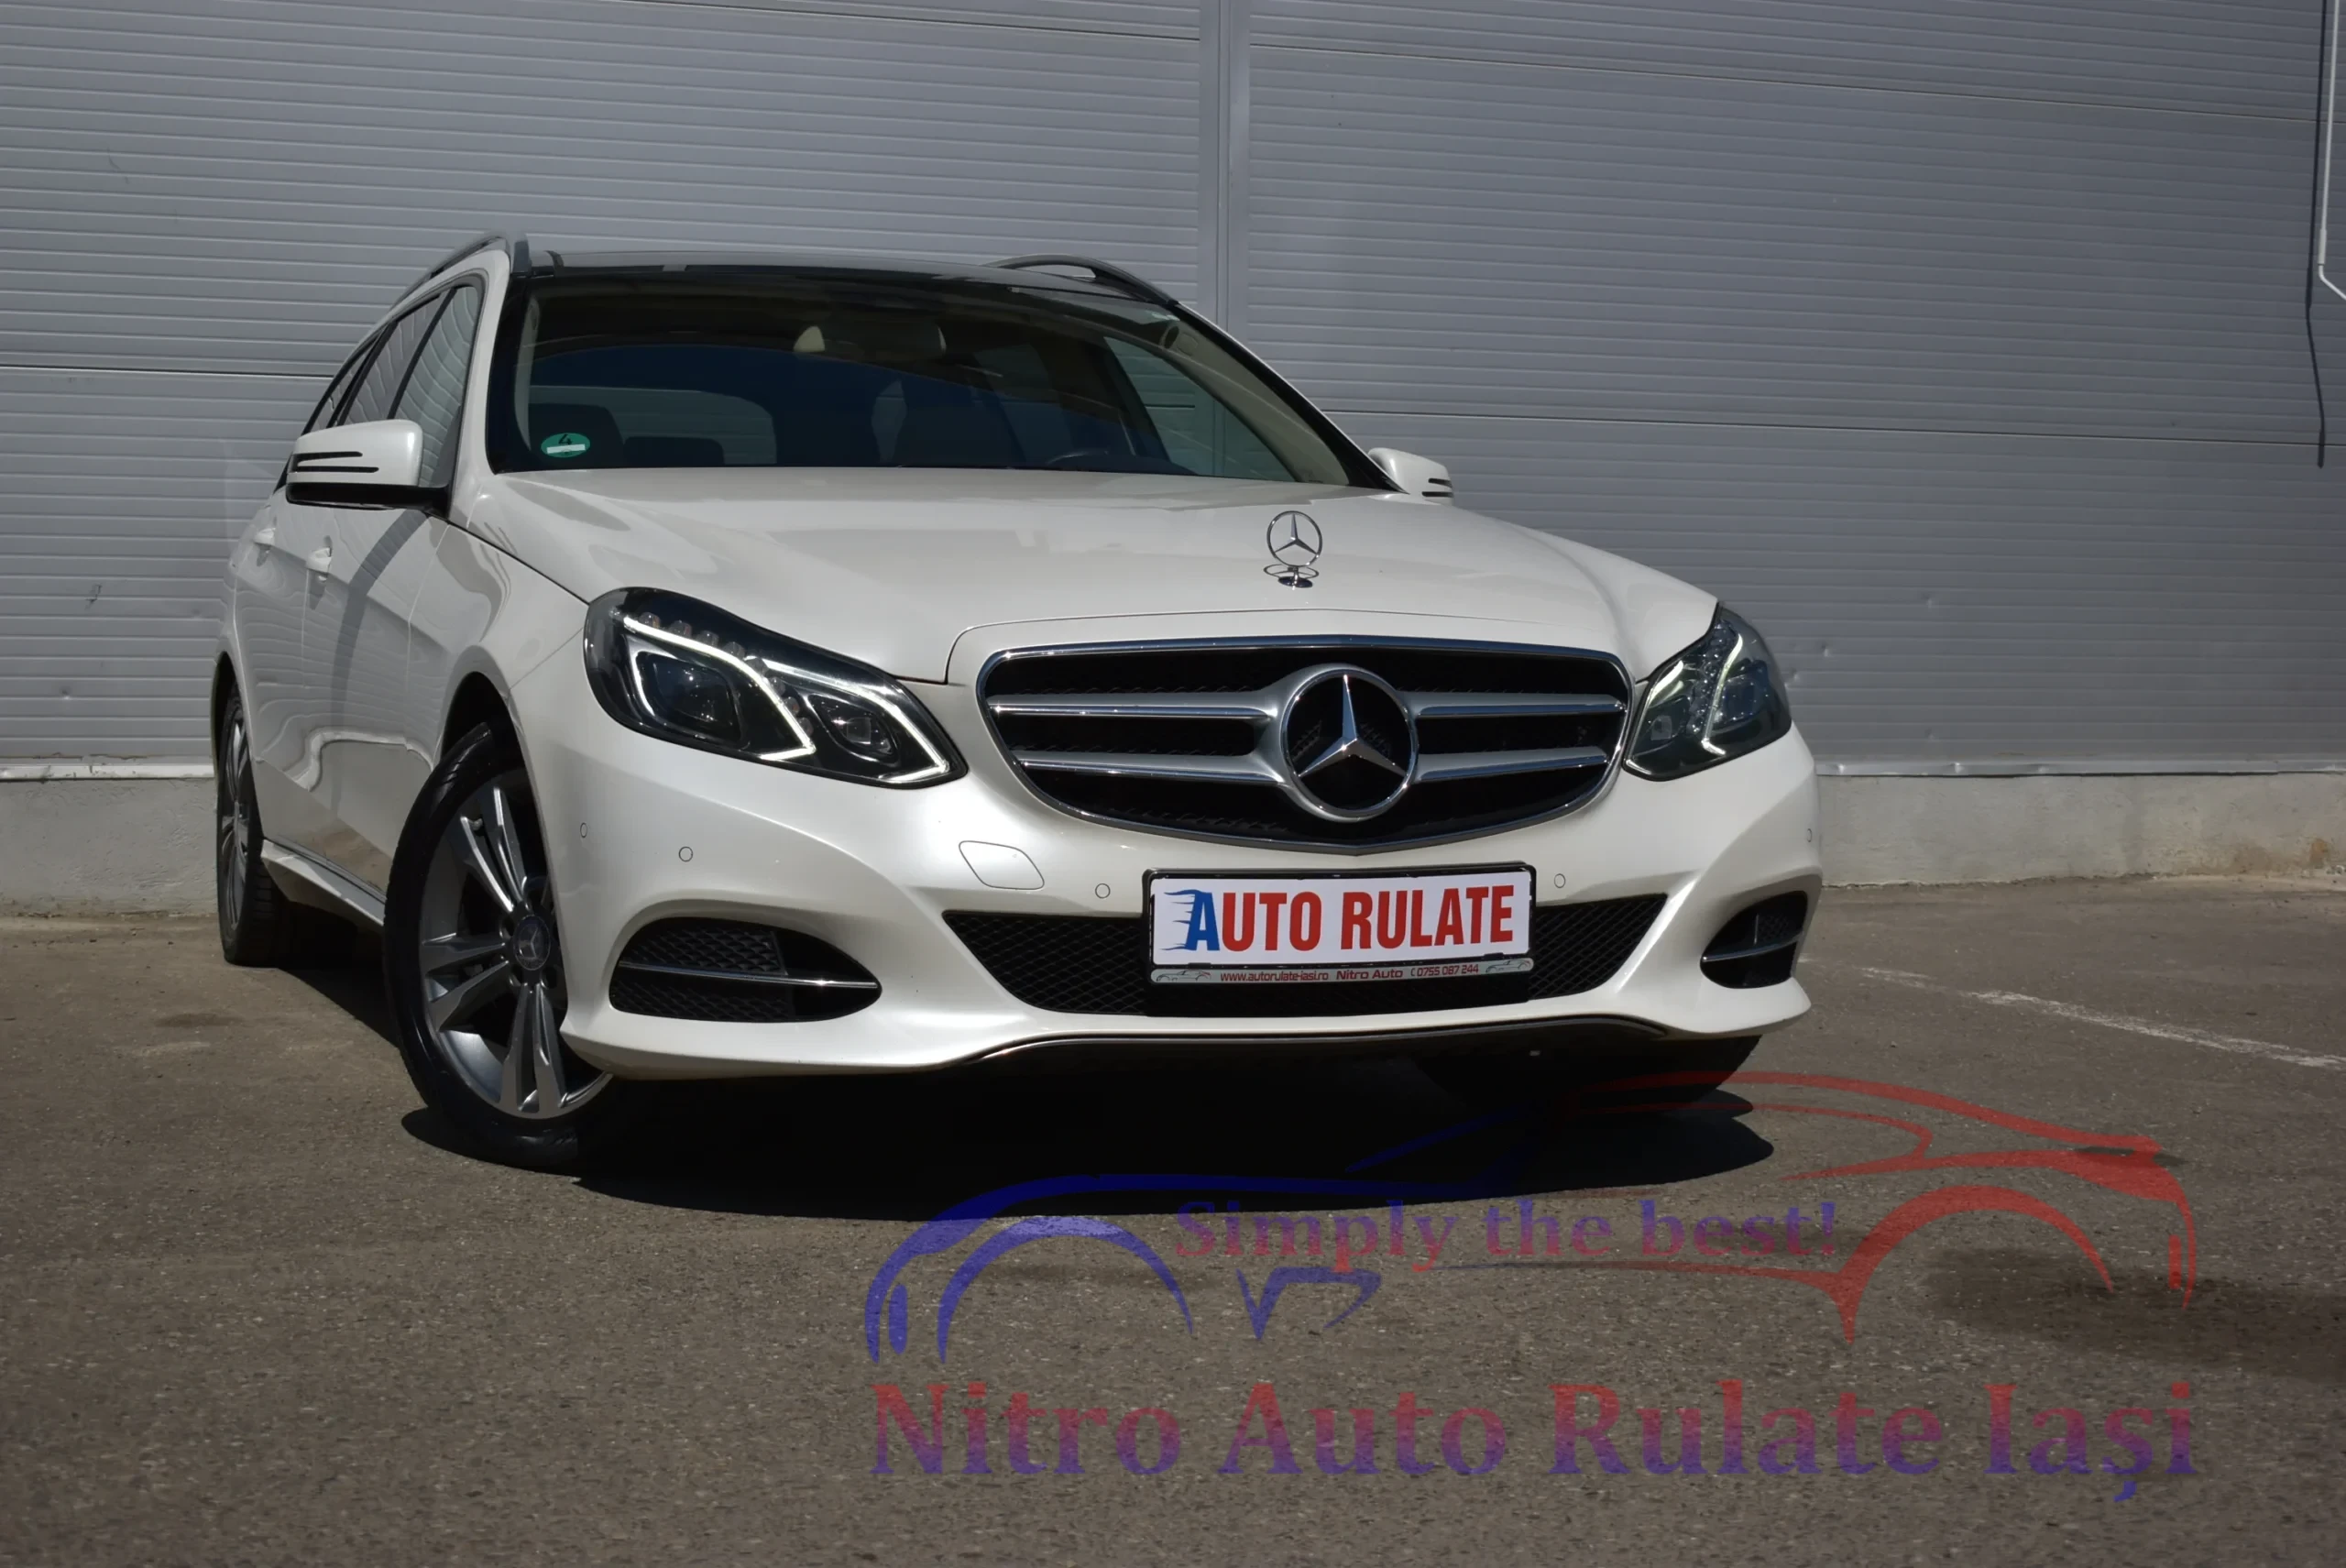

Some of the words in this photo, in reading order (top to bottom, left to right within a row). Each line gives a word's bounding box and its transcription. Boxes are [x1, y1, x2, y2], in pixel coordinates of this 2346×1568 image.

[1164, 888, 1322, 952] AUTO
[1341, 884, 1514, 950] RULATE
[1220, 970, 1330, 982] www.autorulate-iasi.ro
[1336, 969, 1369, 980] Nitro
[1372, 969, 1404, 980] Auto
[1416, 966, 1441, 977] 0755
[1442, 965, 1460, 976] 087
[1461, 964, 1479, 975] 244
